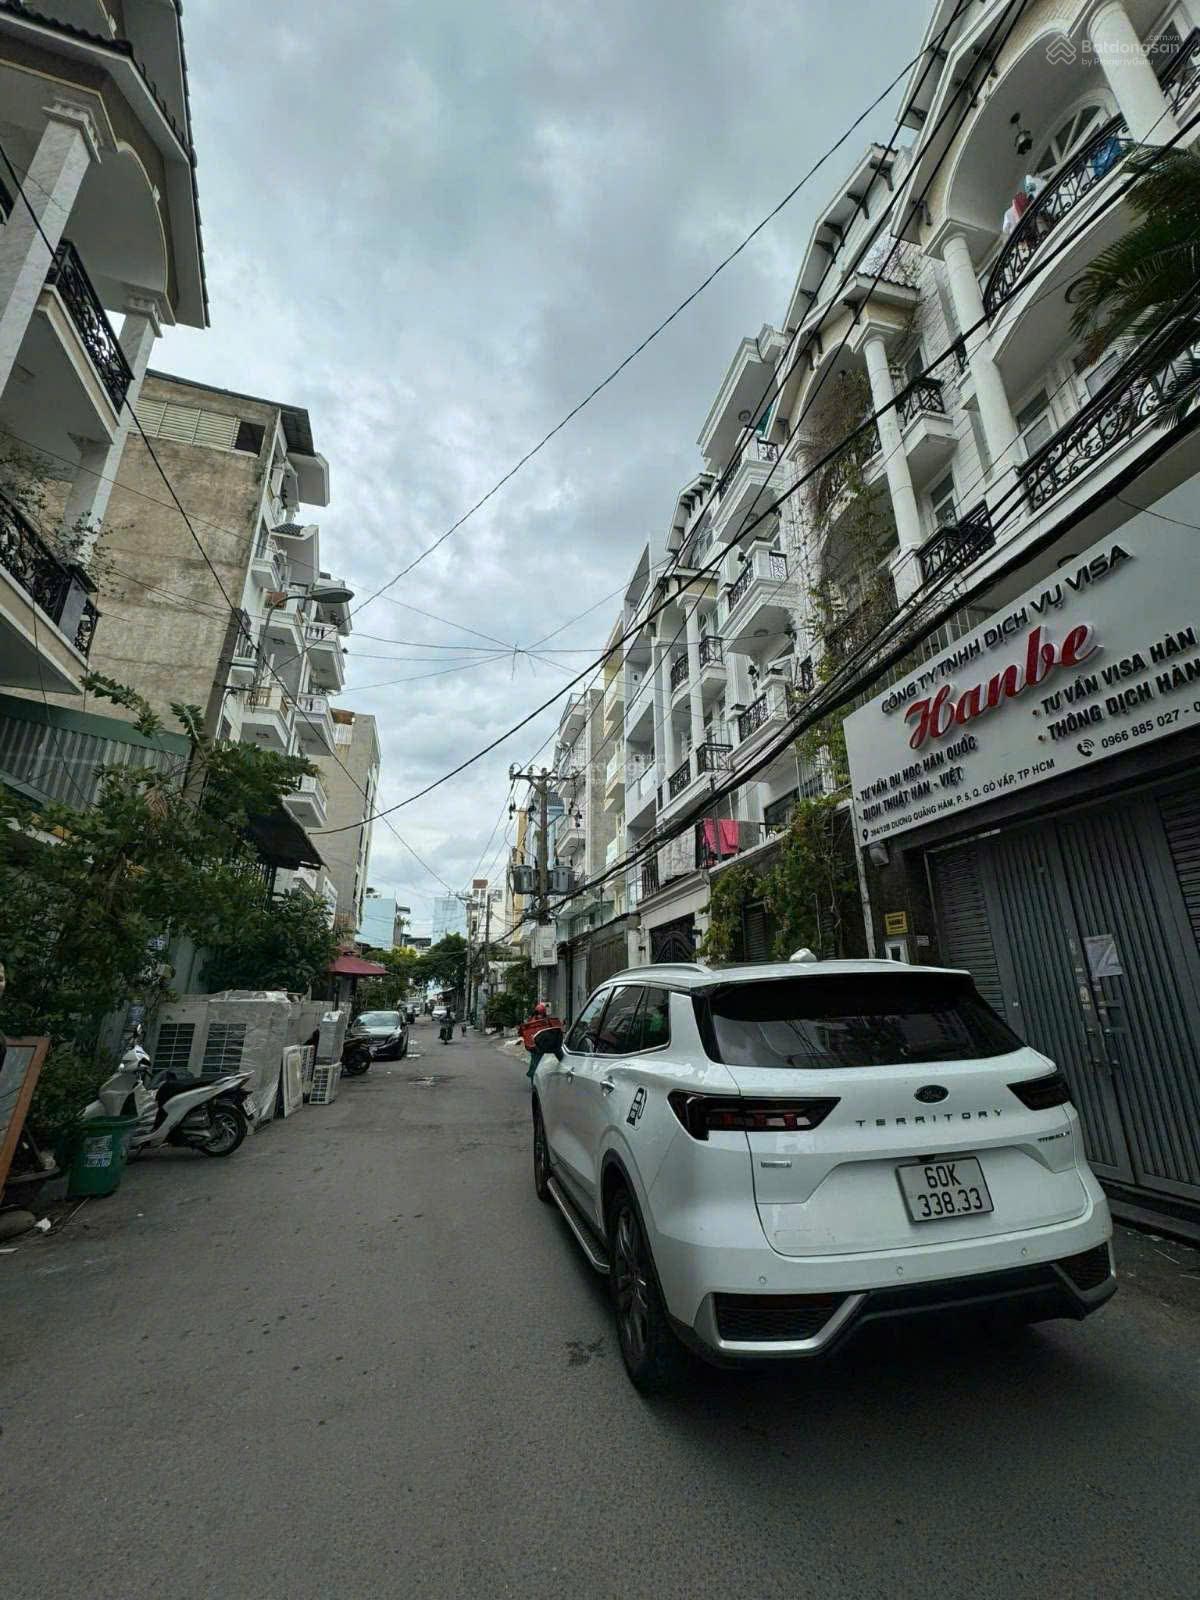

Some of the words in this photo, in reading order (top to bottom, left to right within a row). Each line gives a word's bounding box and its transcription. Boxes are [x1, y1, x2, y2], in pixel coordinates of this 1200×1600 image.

[881, 680, 917, 714] CÔNG
[917, 670, 937, 690] TY
[937, 639, 982, 677] TNHH
[983, 608, 1030, 648] DỊCH
[1030, 584, 1064, 614] VỤ
[1064, 544, 1132, 592] VISA
[904, 624, 1104, 750] Hanbe
[1041, 690, 1061, 715] TƯ
[1064, 674, 1100, 704] VẤN
[1101, 653, 1147, 686] VISA
[1149, 627, 1198, 664] HÀN
[1047, 704, 1103, 742] THÔNG
[1105, 681, 1154, 716] DỊCH
[1155, 657, 1200, 695] HÀN
[1101, 730, 1130, 749] 0966
[1131, 720, 1155, 738] 885
[1156, 708, 1181, 728] 027
[889, 772, 901, 788] DU
[902, 763, 922, 782] HỌC
[923, 751, 945, 772] HÀN
[946, 733, 977, 760] QUỐC
[939, 766, 964, 788] VIỆT
[1017, 768, 1031, 781] TP
[1032, 759, 1056, 776] HCM
[855, 1109, 1003, 1128] TERRITORY
[923, 1163, 962, 1189] 60K
[916, 1187, 983, 1219] 338.33
